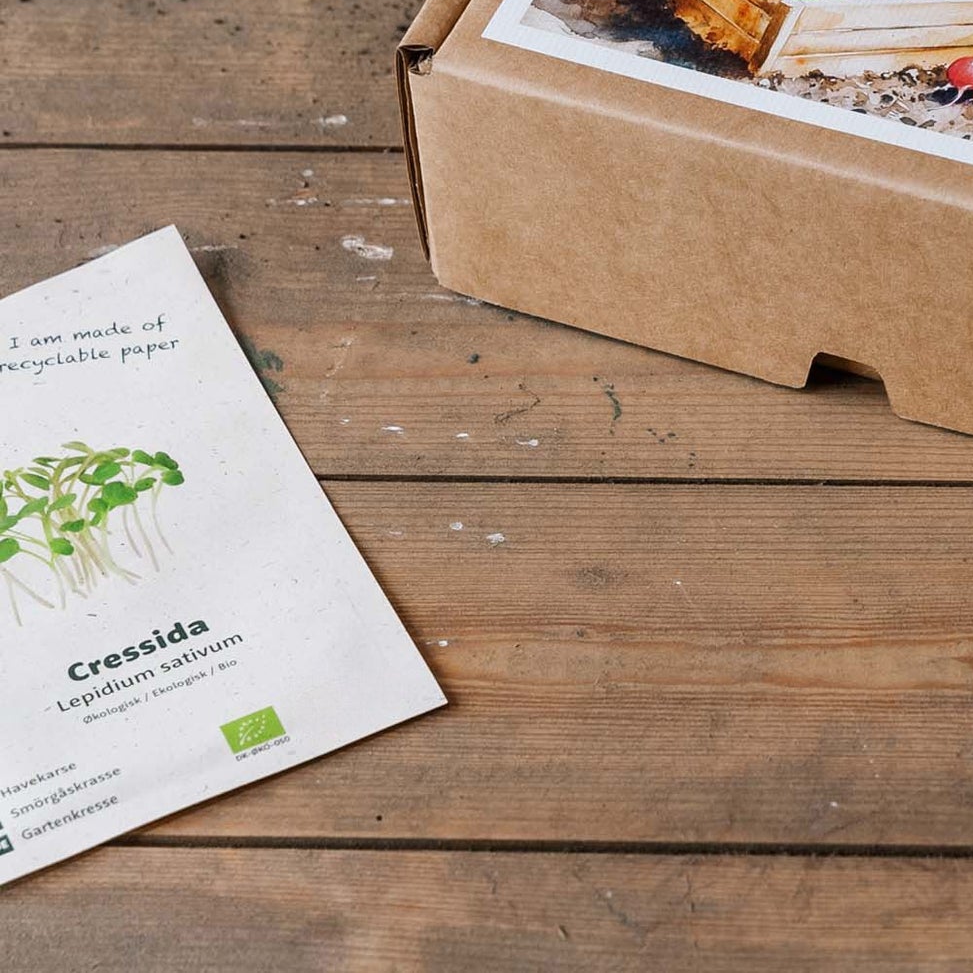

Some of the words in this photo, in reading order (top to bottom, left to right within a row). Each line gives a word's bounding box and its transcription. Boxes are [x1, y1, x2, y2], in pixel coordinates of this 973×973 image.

[9, 337, 19, 350] I
[30, 335, 62, 348] am
[73, 322, 133, 342] made
[142, 313, 166, 332] of
[0, 348, 111, 375] recyclable
[121, 339, 179, 364] paper
[57, 669, 155, 712] Lepidium
[160, 633, 243, 672] sativum
[67, 619, 210, 682] Cressida
[83, 696, 142, 725] Økologisk
[152, 670, 208, 698] Ekologisk
[218, 659, 238, 672] Bio
[0, 762, 77, 797] Havekarse
[10, 768, 122, 818] Smörgåskrasse
[21, 795, 119, 840] Gartenkresse
